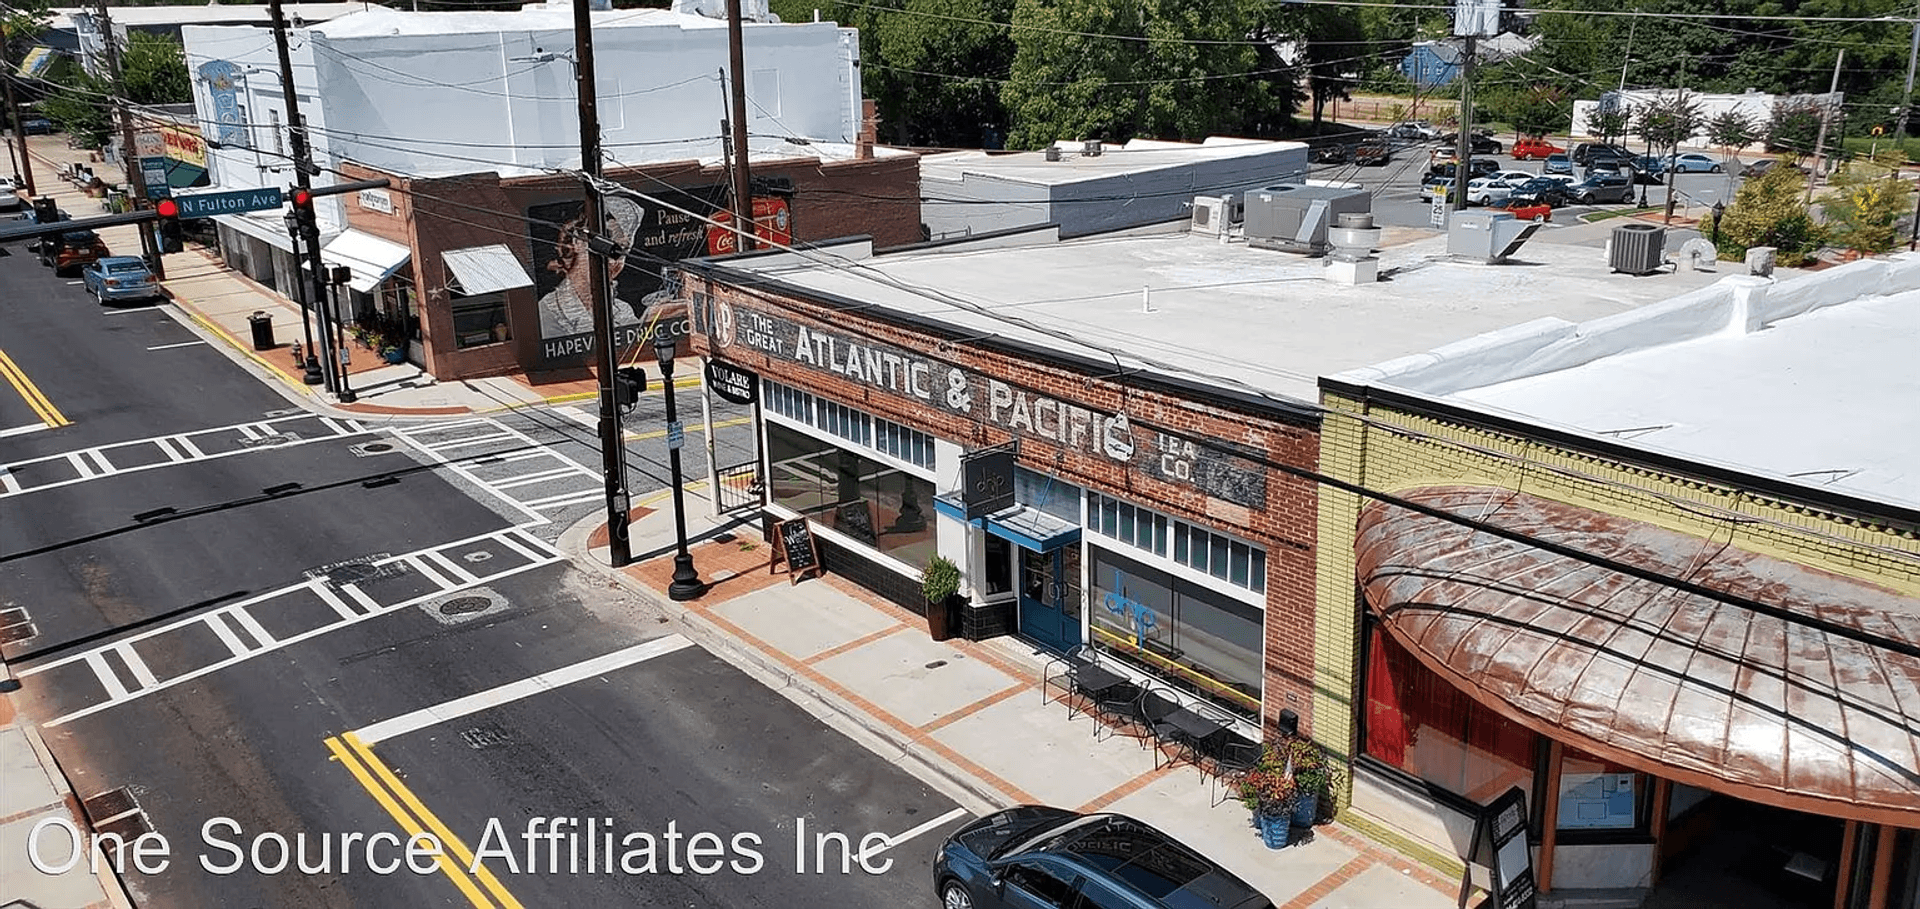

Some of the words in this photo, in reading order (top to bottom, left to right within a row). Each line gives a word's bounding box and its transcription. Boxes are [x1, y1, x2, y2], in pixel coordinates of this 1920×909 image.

[182, 200, 193, 212] N
[199, 197, 246, 211] Fulton
[251, 194, 277, 207] Ave
[1433, 203, 1444, 215] 25
[657, 209, 691, 226] Pause
[644, 229, 666, 248] and
[752, 312, 774, 335] THE
[545, 333, 622, 358] HAPEVE
[626, 324, 660, 345] DRUG
[746, 328, 783, 355] GREAT
[711, 364, 750, 389] VOLARE
[794, 324, 931, 399] ATLANTIC
[946, 367, 973, 413] &
[989, 378, 1134, 462] PACIFIC
[1161, 453, 1196, 483] CO.
